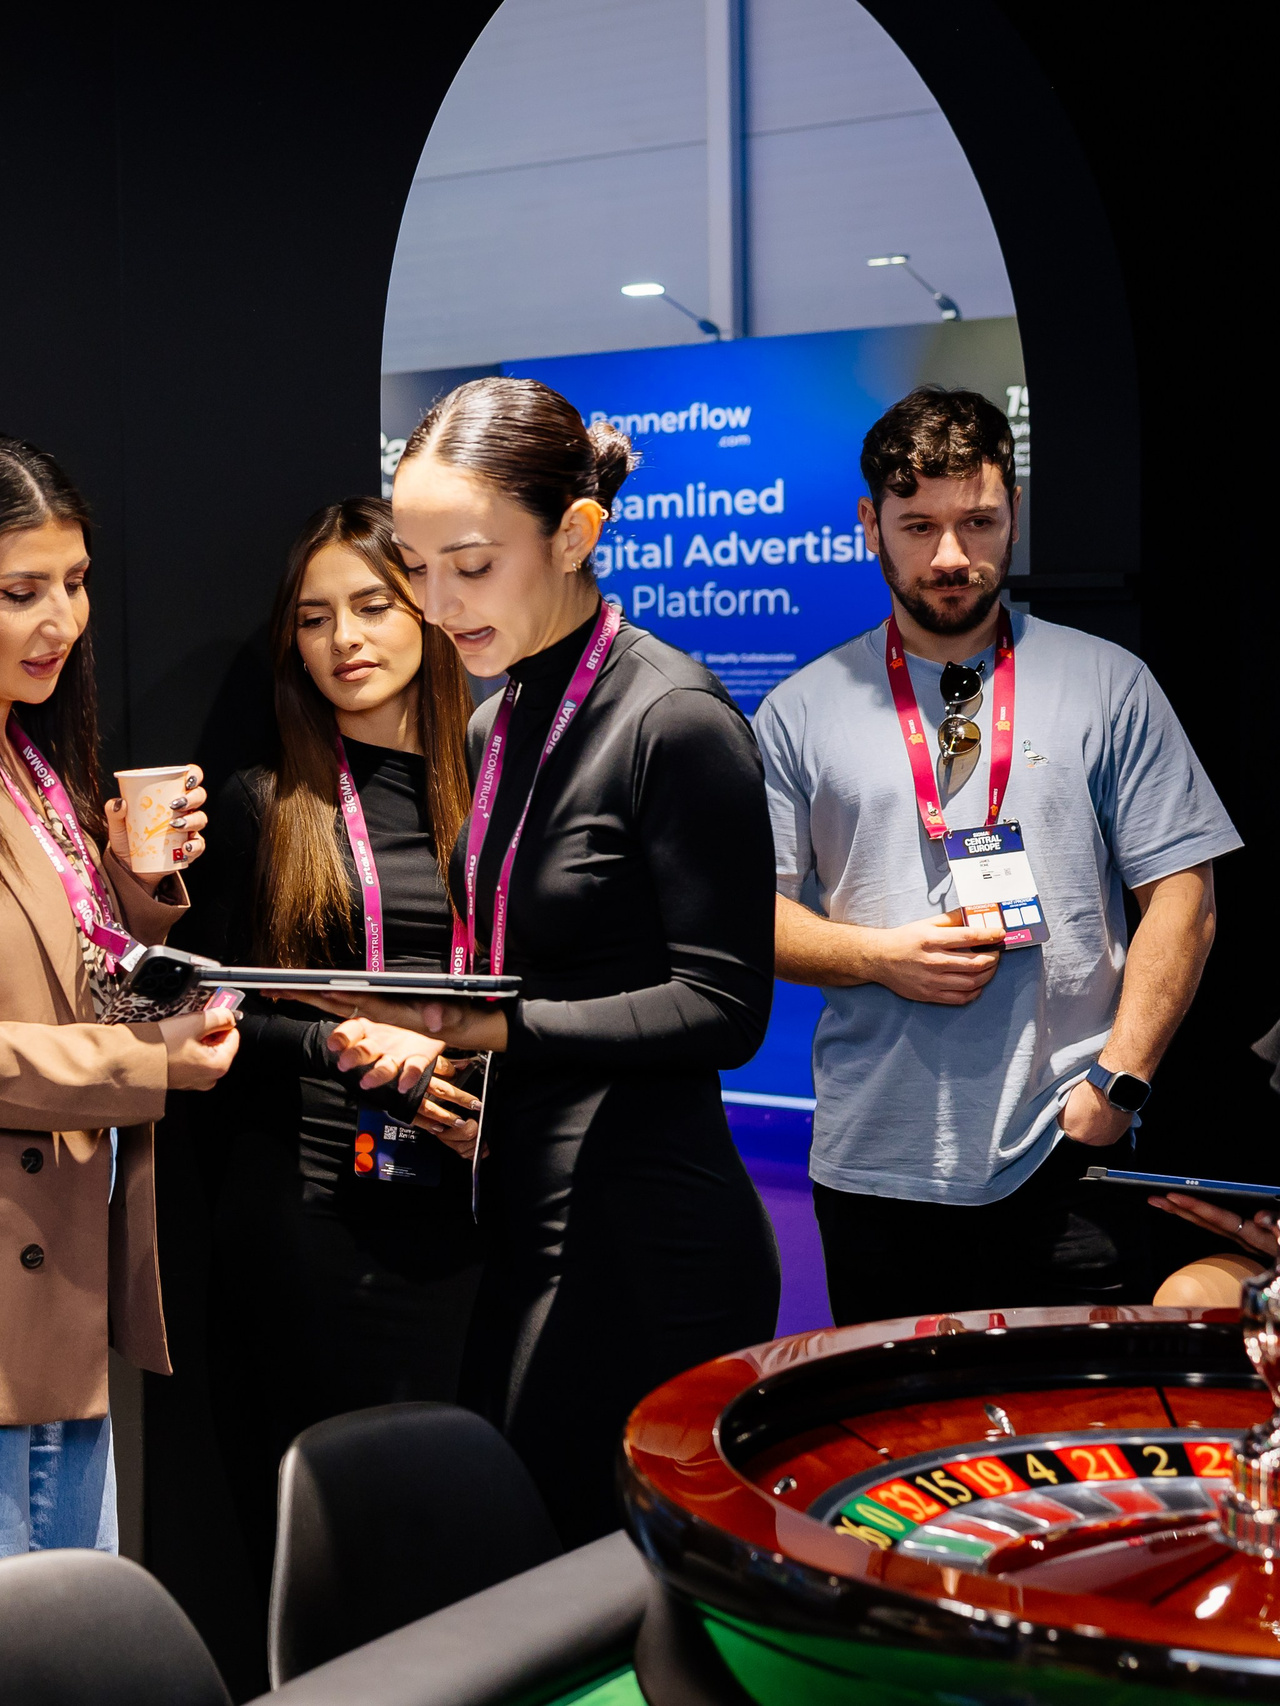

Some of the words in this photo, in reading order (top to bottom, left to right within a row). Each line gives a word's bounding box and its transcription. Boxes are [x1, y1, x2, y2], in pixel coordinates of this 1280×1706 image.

[718, 434, 751, 448] .com
[683, 523, 876, 568] Advertisi
[632, 581, 799, 618] Platform.
[478, 735, 502, 811] BETCONSTRUCT
[965, 834, 1002, 847] CENTRAL
[969, 842, 1001, 854] EUROPE
[1026, 1453, 1058, 1485] 4
[1071, 1448, 1126, 1481] 21
[1142, 1445, 1178, 1476] 2
[915, 1470, 972, 1506] 15
[960, 1461, 1014, 1495] 19
[856, 1503, 905, 1532] 0
[878, 1485, 941, 1520] 32
